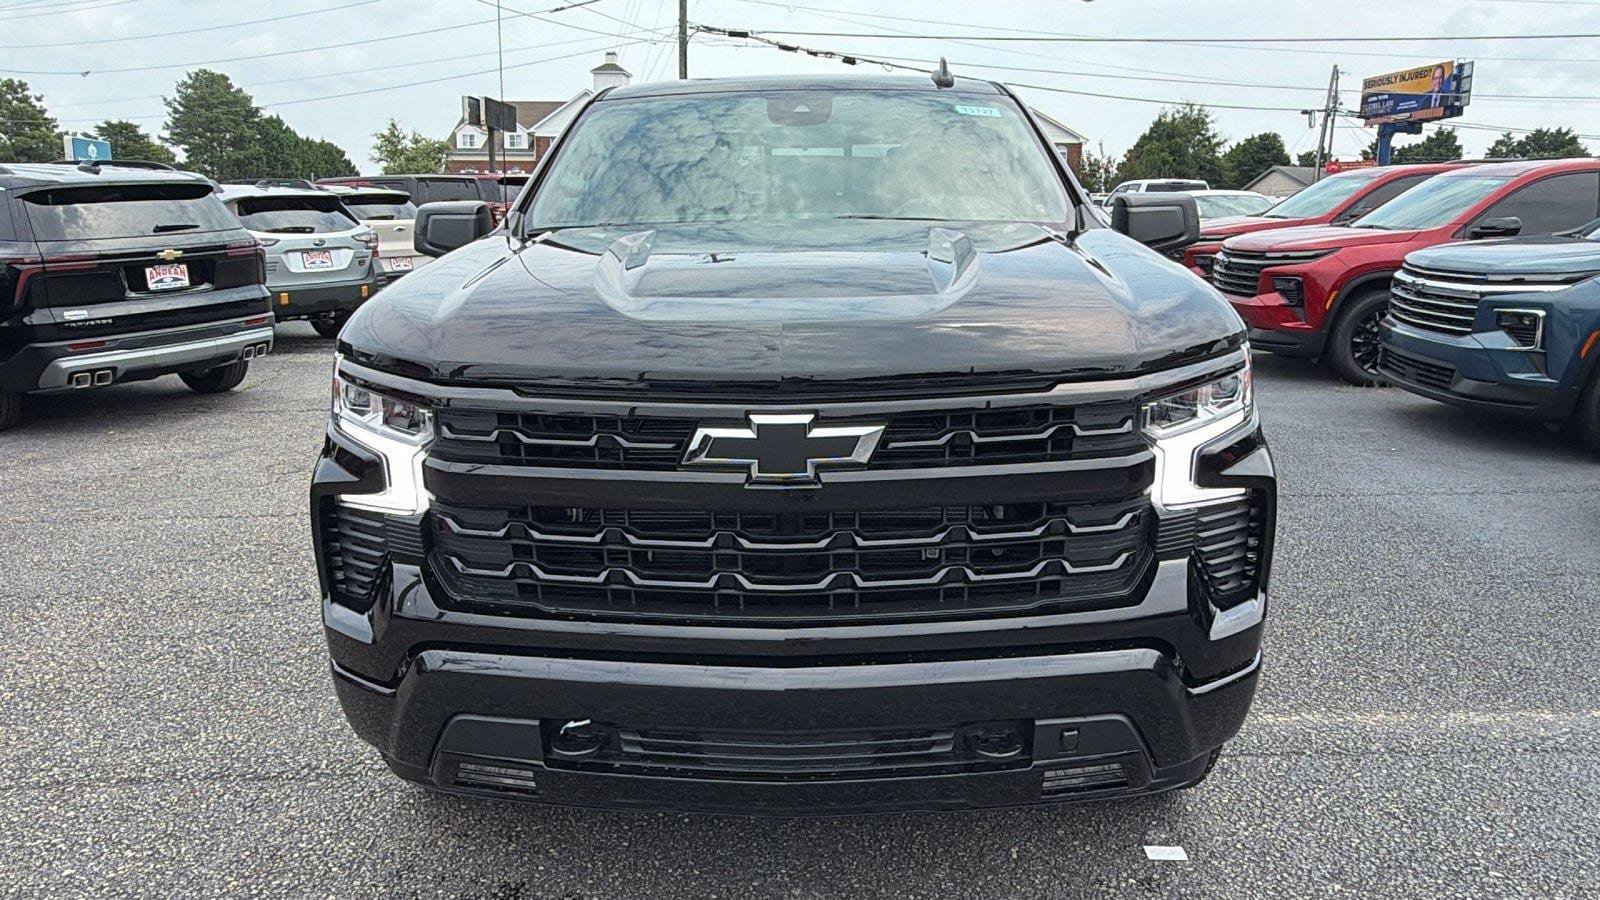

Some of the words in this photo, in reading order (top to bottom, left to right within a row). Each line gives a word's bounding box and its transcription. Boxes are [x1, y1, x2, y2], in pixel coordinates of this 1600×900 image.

[1364, 74, 1398, 89] SERIOUSLY
[1399, 68, 1432, 83] INJURED?
[149, 265, 187, 280] ANDEAN
